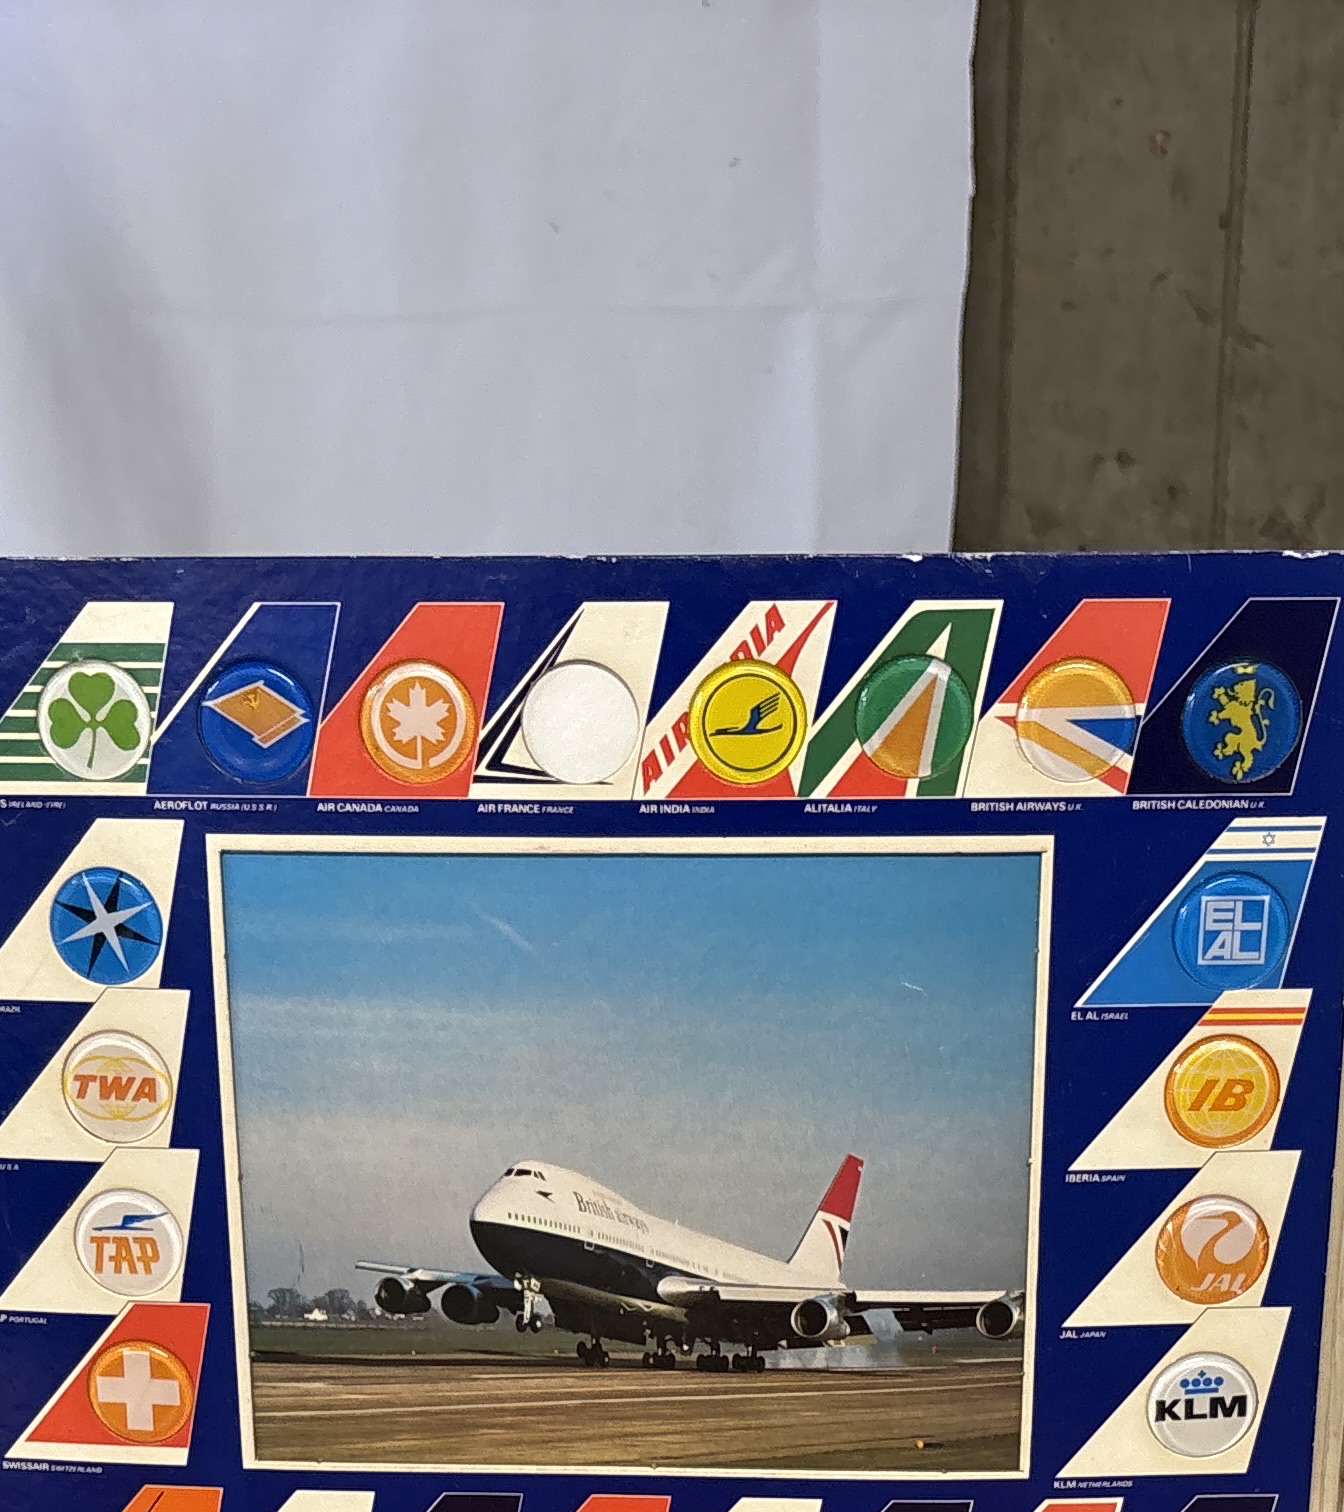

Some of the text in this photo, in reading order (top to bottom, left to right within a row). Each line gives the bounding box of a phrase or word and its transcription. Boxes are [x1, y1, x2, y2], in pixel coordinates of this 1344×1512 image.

[154, 800, 208, 811] AEROFLOT
[317, 802, 335, 812] AIR
[336, 802, 383, 812] CANADA
[477, 803, 496, 813] AIR
[497, 804, 540, 814] FRANCE
[639, 804, 658, 814] AIR
[660, 804, 690, 814] INDIA
[804, 803, 852, 813] ALITALIA
[971, 801, 1066, 812] BRITISH AIRWAYS
[1132, 799, 1249, 810] BRITISH CALEDONIAN
[1206, 901, 1262, 930] EL
[1204, 931, 1259, 960] AL
[1071, 1011, 1084, 1021] EL
[1085, 1011, 1099, 1020] AL
[72, 1074, 157, 1103] TWA
[1187, 1079, 1255, 1112] IB
[1065, 1173, 1100, 1183] IBERIA
[90, 1236, 160, 1275] TAP
[1191, 1273, 1248, 1294] JAL
[1059, 1330, 1078, 1339] JAL
[1155, 1395, 1248, 1422] KLM
[1053, 1480, 1077, 1489] KLM
